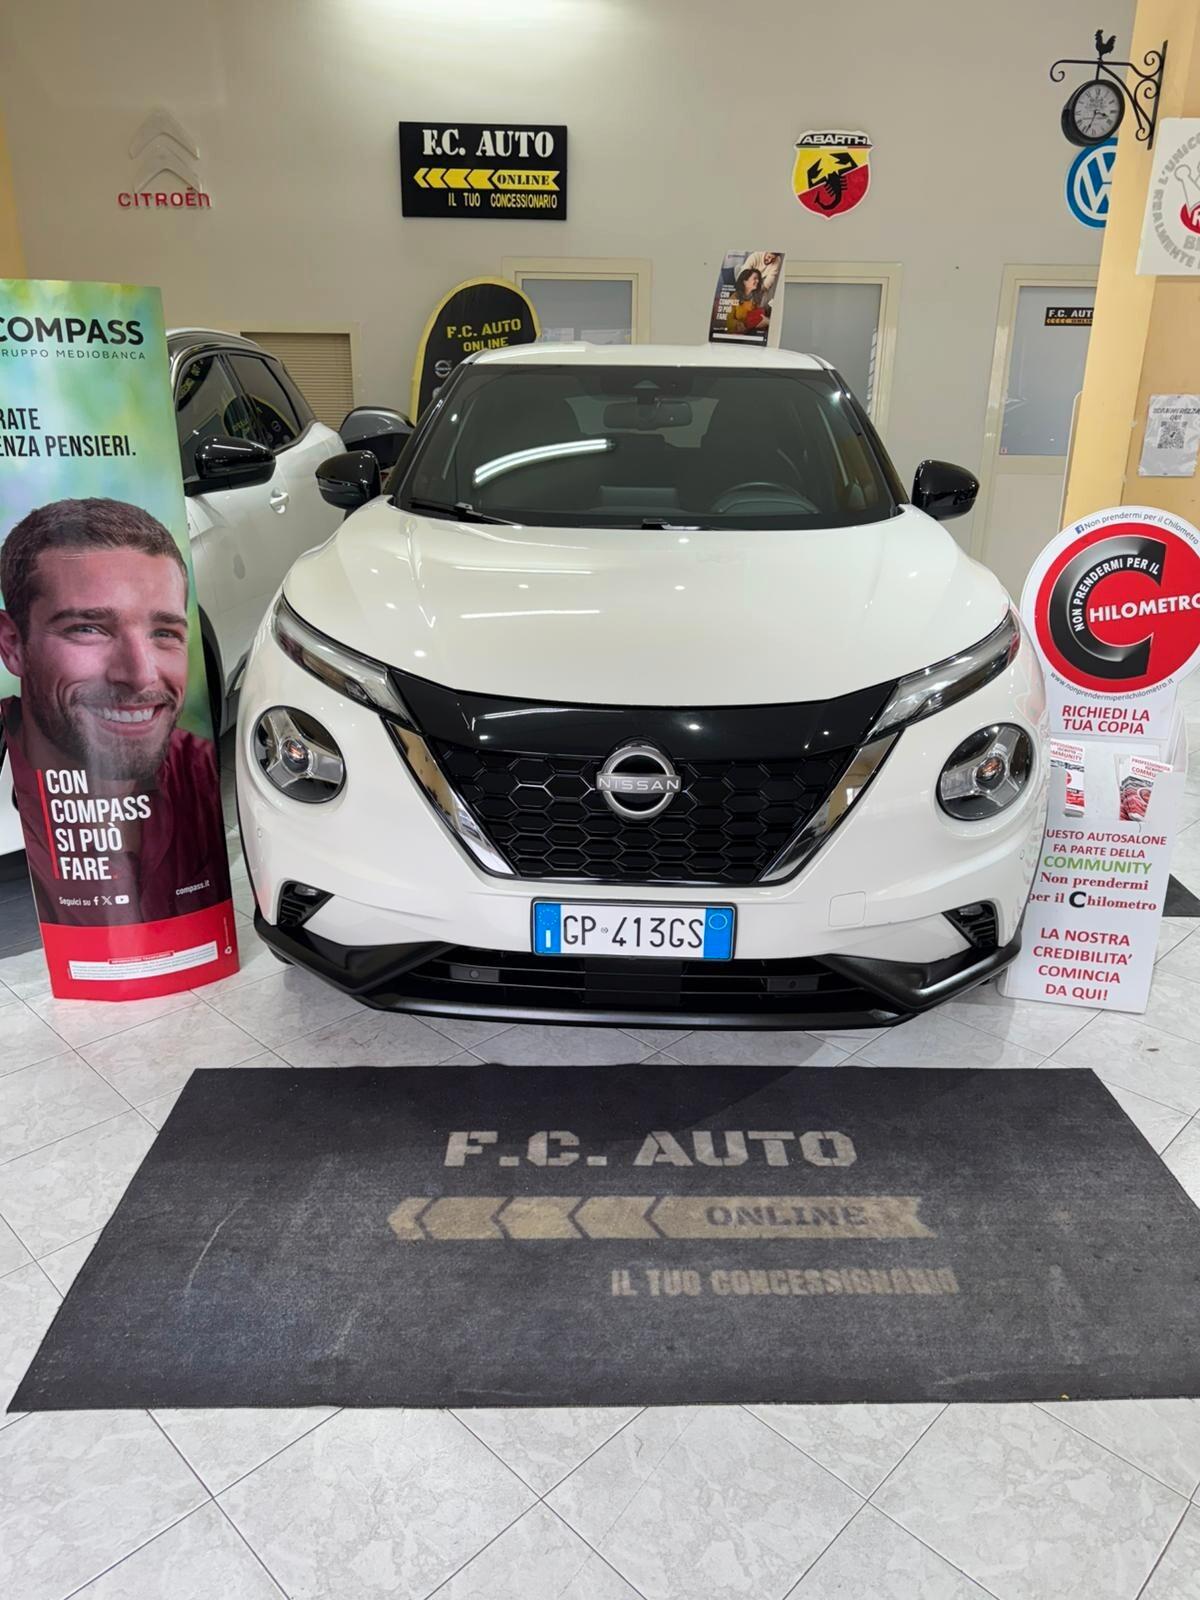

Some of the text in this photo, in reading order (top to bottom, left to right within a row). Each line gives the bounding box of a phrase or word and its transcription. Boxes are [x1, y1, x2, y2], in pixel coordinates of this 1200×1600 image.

[422, 129, 554, 158] F.C. AUTO
[801, 134, 866, 145] ABARTH
[496, 175, 550, 186] ONLINE
[448, 193, 558, 209] IL TUO CONCESSIONARIO
[1152, 189, 1195, 268] REALMENTE
[1070, 310, 1093, 318] AUT
[446, 318, 522, 339] F.C. AUTO
[2, 348, 146, 360] RUPPO MEDIOBANCA
[463, 337, 509, 352] ONLINE
[0, 435, 137, 457] NZA PENSIERI.
[1084, 519, 1101, 530] Non
[1102, 512, 1142, 524] prendermi
[1143, 513, 1157, 521] per
[1163, 518, 1199, 545] Chilometro
[1072, 557, 1161, 632] NON PRENDERMI PER IL
[1062, 705, 1151, 722] RICHIEDI LA
[1063, 718, 1145, 734] TUA COPIA
[45, 769, 89, 795] CON
[598, 777, 680, 791] NISSAN
[50, 795, 152, 824] COMPASS
[55, 822, 123, 853] SI PUÒ
[1046, 829, 1167, 846] UESTO AUTOSALONE
[1053, 843, 1146, 859] FA PARTE DELLA
[1043, 855, 1152, 875] COMMUNITY
[175, 879, 210, 896] compass.it
[1040, 872, 1149, 890] Non prendermi
[58, 896, 82, 907] Seguici
[1055, 892, 1065, 903] il
[1068, 891, 1157, 911] Chilometro
[563, 915, 704, 949] GP 413GS
[1041, 927, 1130, 946] LA NOSTRA
[1033, 945, 1133, 966] CREDIBILITA'
[1038, 965, 1121, 984] COMINCIA
[1045, 983, 1109, 1001] DA QUI!
[443, 1130, 858, 1167] F.C. AUTO
[705, 1205, 869, 1227] ONLINE
[611, 1266, 961, 1297] IL TUO CONCESSIONARIO
